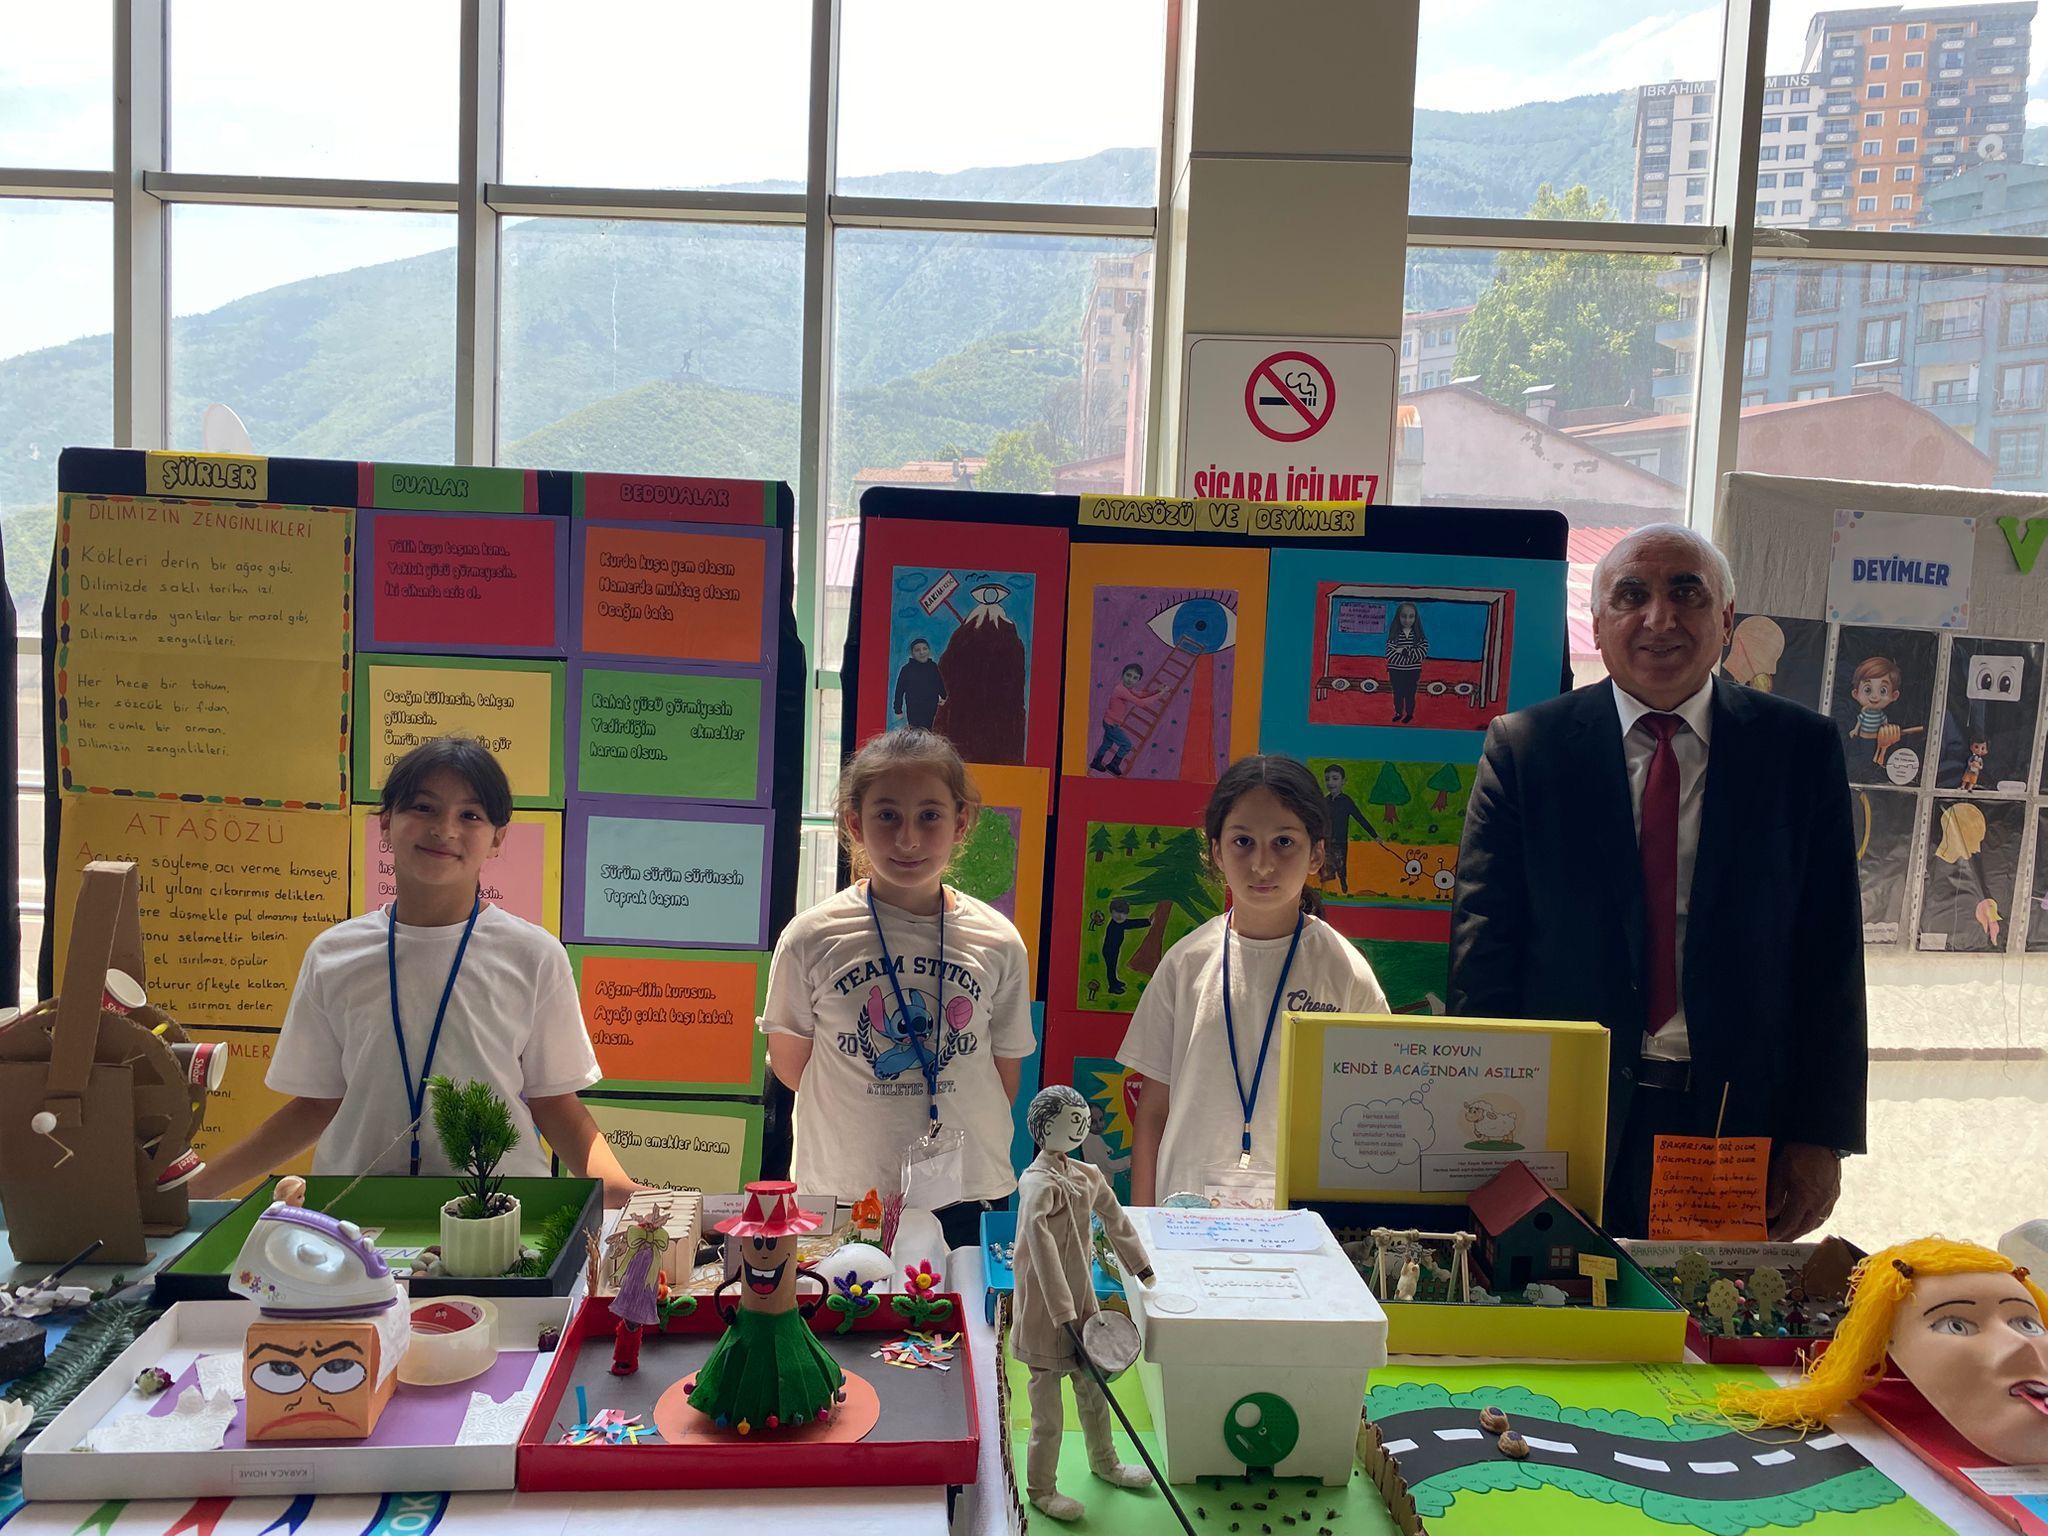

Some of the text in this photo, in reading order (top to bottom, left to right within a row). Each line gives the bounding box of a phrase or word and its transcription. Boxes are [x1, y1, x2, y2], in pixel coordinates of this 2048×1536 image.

[1643, 83, 1705, 97] IBRAHIM
[162, 457, 257, 490] ŞİİRLER
[392, 474, 469, 497] DUALAR
[620, 483, 730, 507] BEDDUALAR
[1093, 498, 1355, 531] ATASÖZÜ VE DEYİMLER
[82, 545, 147, 567] Kökleri
[600, 552, 735, 576] Kurda kuşa yem olasın
[1852, 555, 1950, 586] DEYİMLER
[80, 575, 148, 592] Dilimizde
[160, 581, 200, 593] saklı
[599, 577, 740, 601] Namerde muhtaç olasın
[80, 603, 158, 620] Kulaklarda
[598, 602, 674, 622] Ocağın bata
[78, 674, 101, 687] Her
[115, 674, 149, 689] hece
[160, 677, 177, 689] bir
[78, 696, 100, 708] Her
[173, 701, 189, 712] bir
[384, 689, 422, 706] Ocağın
[478, 693, 515, 711] bahçen
[591, 692, 733, 719] Rahat yüzü görmiyesin
[79, 719, 97, 729] Her
[156, 721, 170, 732] bir
[384, 711, 437, 726] güllensin.
[591, 717, 746, 741] Yedirdiğim ekmekler
[384, 729, 419, 746] Ömrün
[492, 736, 512, 752] gür
[590, 742, 668, 760] haram olsun.
[124, 812, 284, 844] ATASÖZÜ
[215, 863, 234, 873] acı
[241, 865, 281, 876] verme
[601, 864, 744, 885] Sürüm sürüm sürünesin
[604, 888, 689, 908] Toprak başına
[234, 909, 252, 925] pul
[153, 953, 168, 965] el
[834, 955, 905, 996] TEAM
[595, 980, 717, 1000] Ağzın-dilin kurusun.
[593, 1005, 734, 1026] Ayağı çolak başı kabak
[592, 1031, 634, 1046] olasın.
[1433, 1045, 1482, 1057] KOYUN
[1332, 1061, 1378, 1075] KENDİ
[1384, 1062, 1479, 1079] BACAĞINDAN
[645, 1134, 691, 1151] emekler
[693, 1136, 730, 1154] haram
